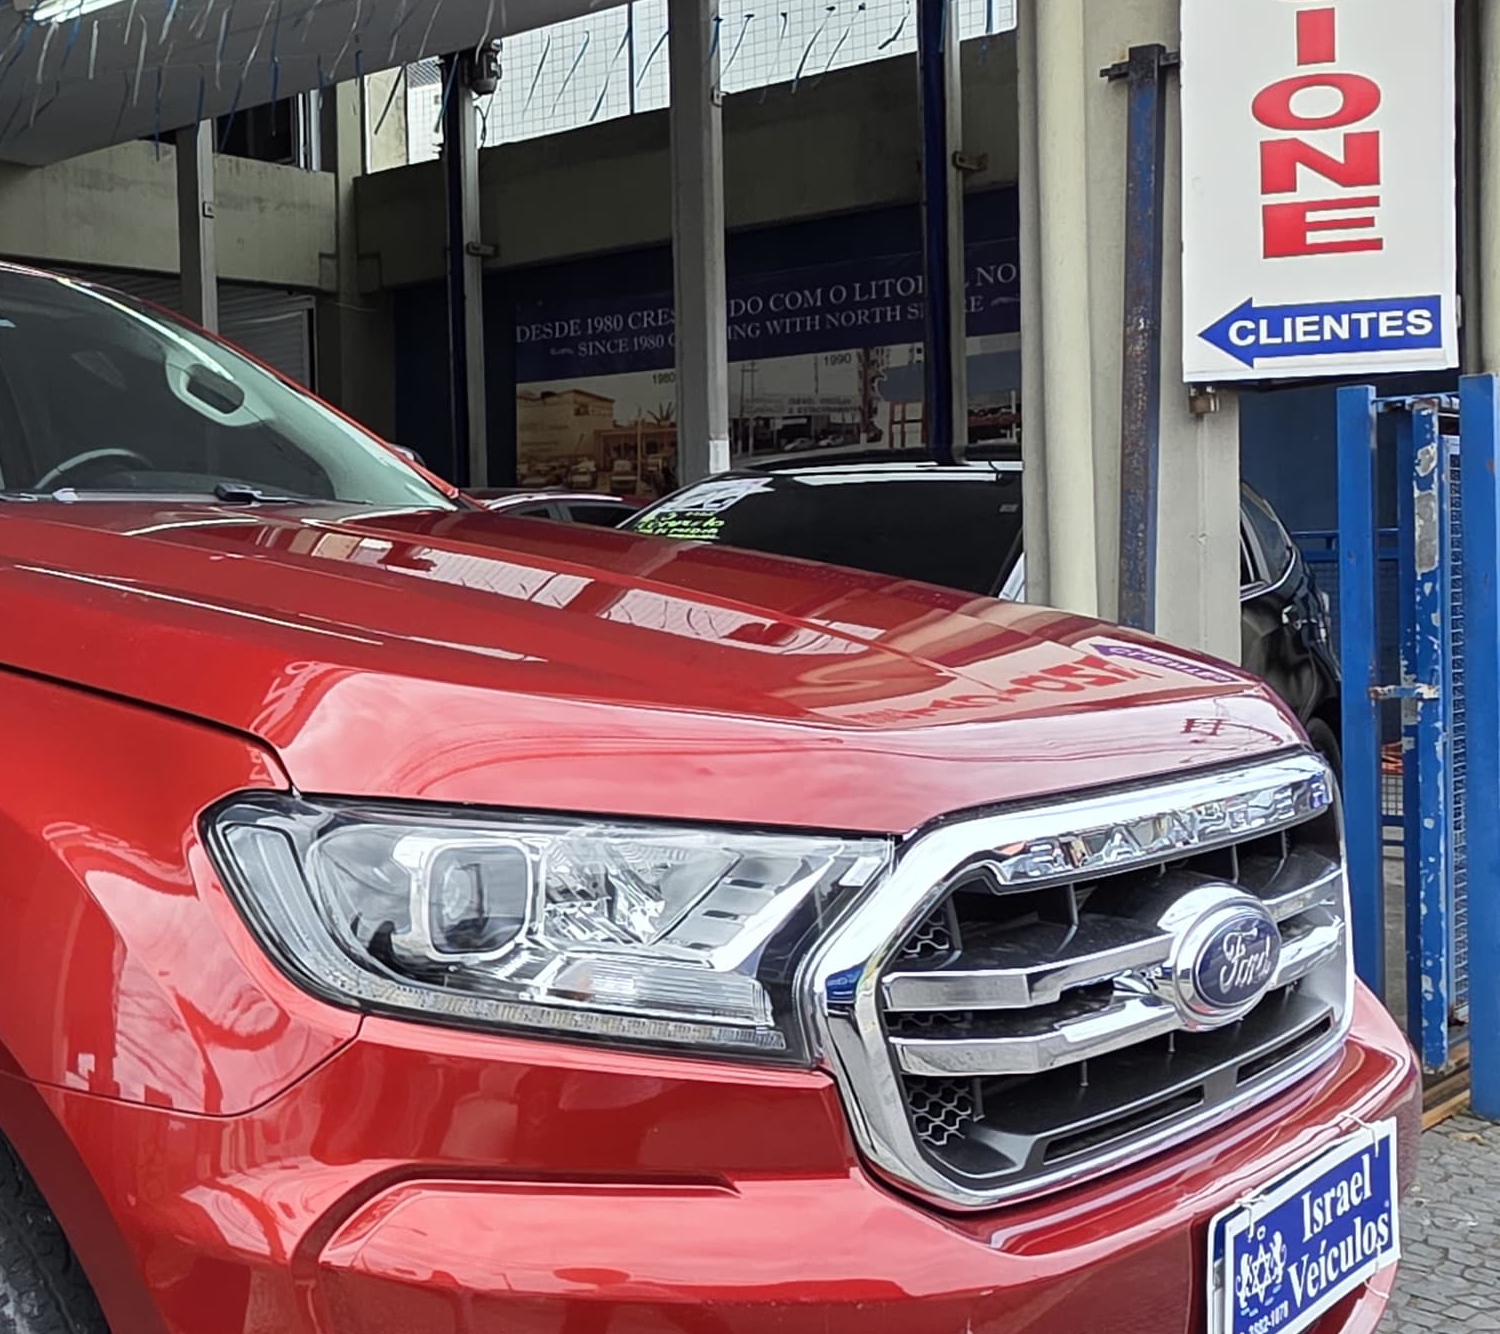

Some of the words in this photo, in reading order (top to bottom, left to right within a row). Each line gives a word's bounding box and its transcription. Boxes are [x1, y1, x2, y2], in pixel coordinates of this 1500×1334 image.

[516, 319, 581, 343] DESDE
[587, 314, 623, 335] 1980
[768, 288, 822, 311] COM
[829, 285, 847, 304] O
[578, 338, 629, 357] SINCE
[633, 334, 664, 352] 1980
[765, 314, 820, 335] WITH
[825, 303, 901, 329] NORTH
[1228, 308, 1434, 347] CLIENTES
[824, 353, 852, 366] 1990
[1219, 927, 1272, 994] Ford
[1302, 1154, 1373, 1243] Israel
[1287, 1212, 1389, 1309] Veículos
